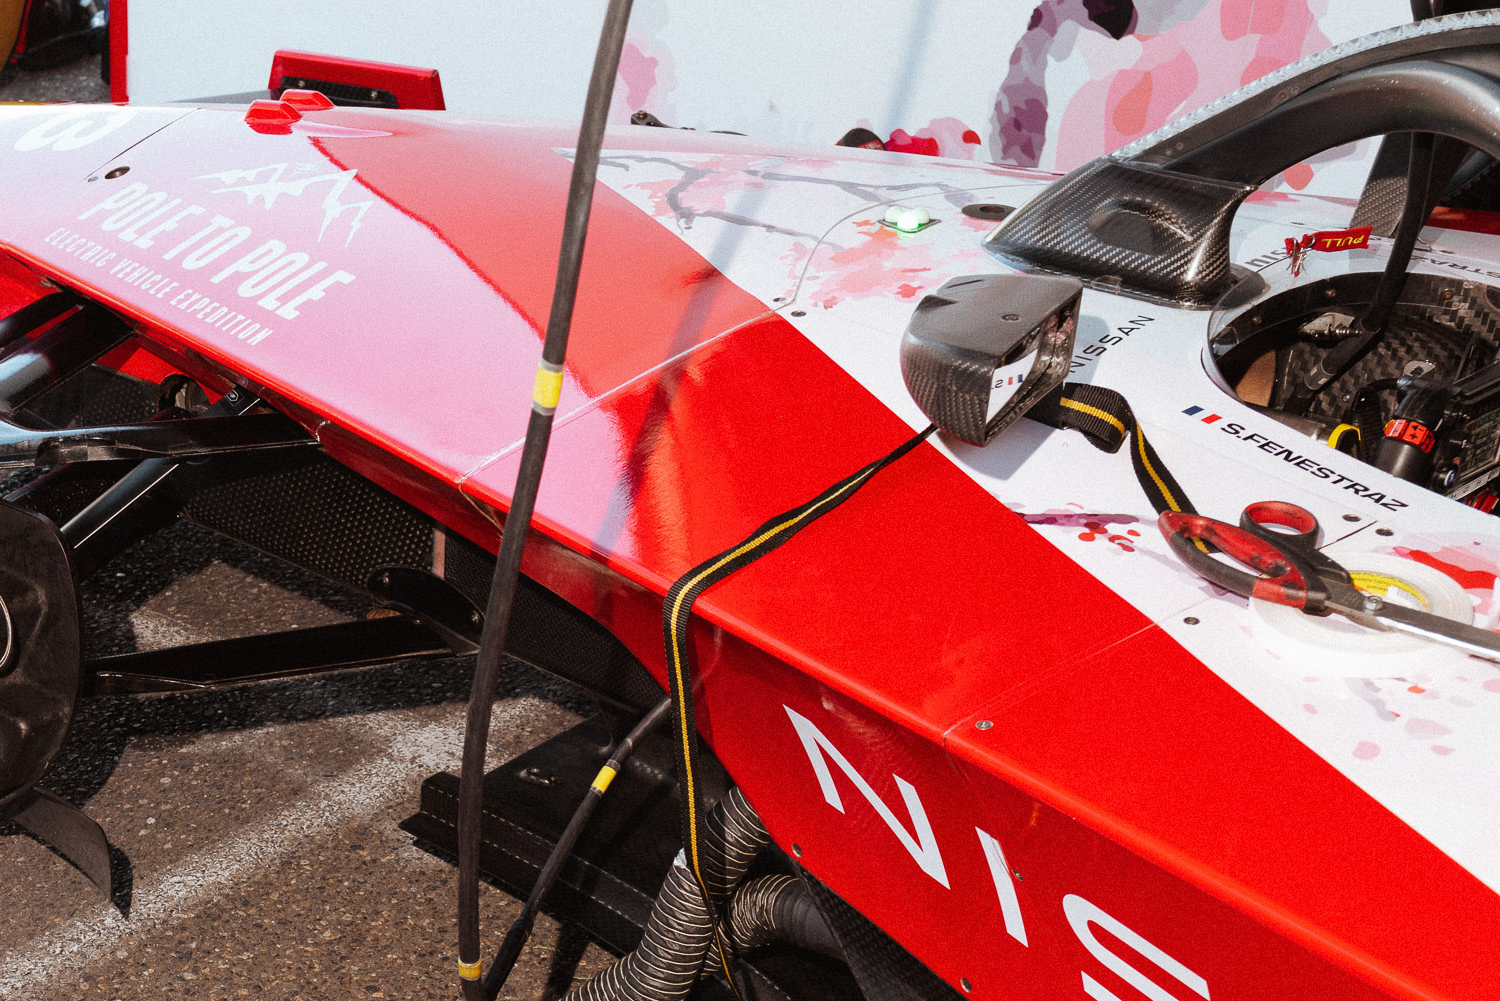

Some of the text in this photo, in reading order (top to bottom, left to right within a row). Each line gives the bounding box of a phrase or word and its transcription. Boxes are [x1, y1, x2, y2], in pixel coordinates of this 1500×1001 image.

[44, 227, 274, 346] ELECTRIC VEHICLE EXPEDITION
[77, 181, 357, 320] POLE TO POLE
[1322, 234, 1366, 249] PULL
[1069, 314, 1156, 374] NISSAN
[1220, 422, 1410, 512] S.FENESTRAZ
